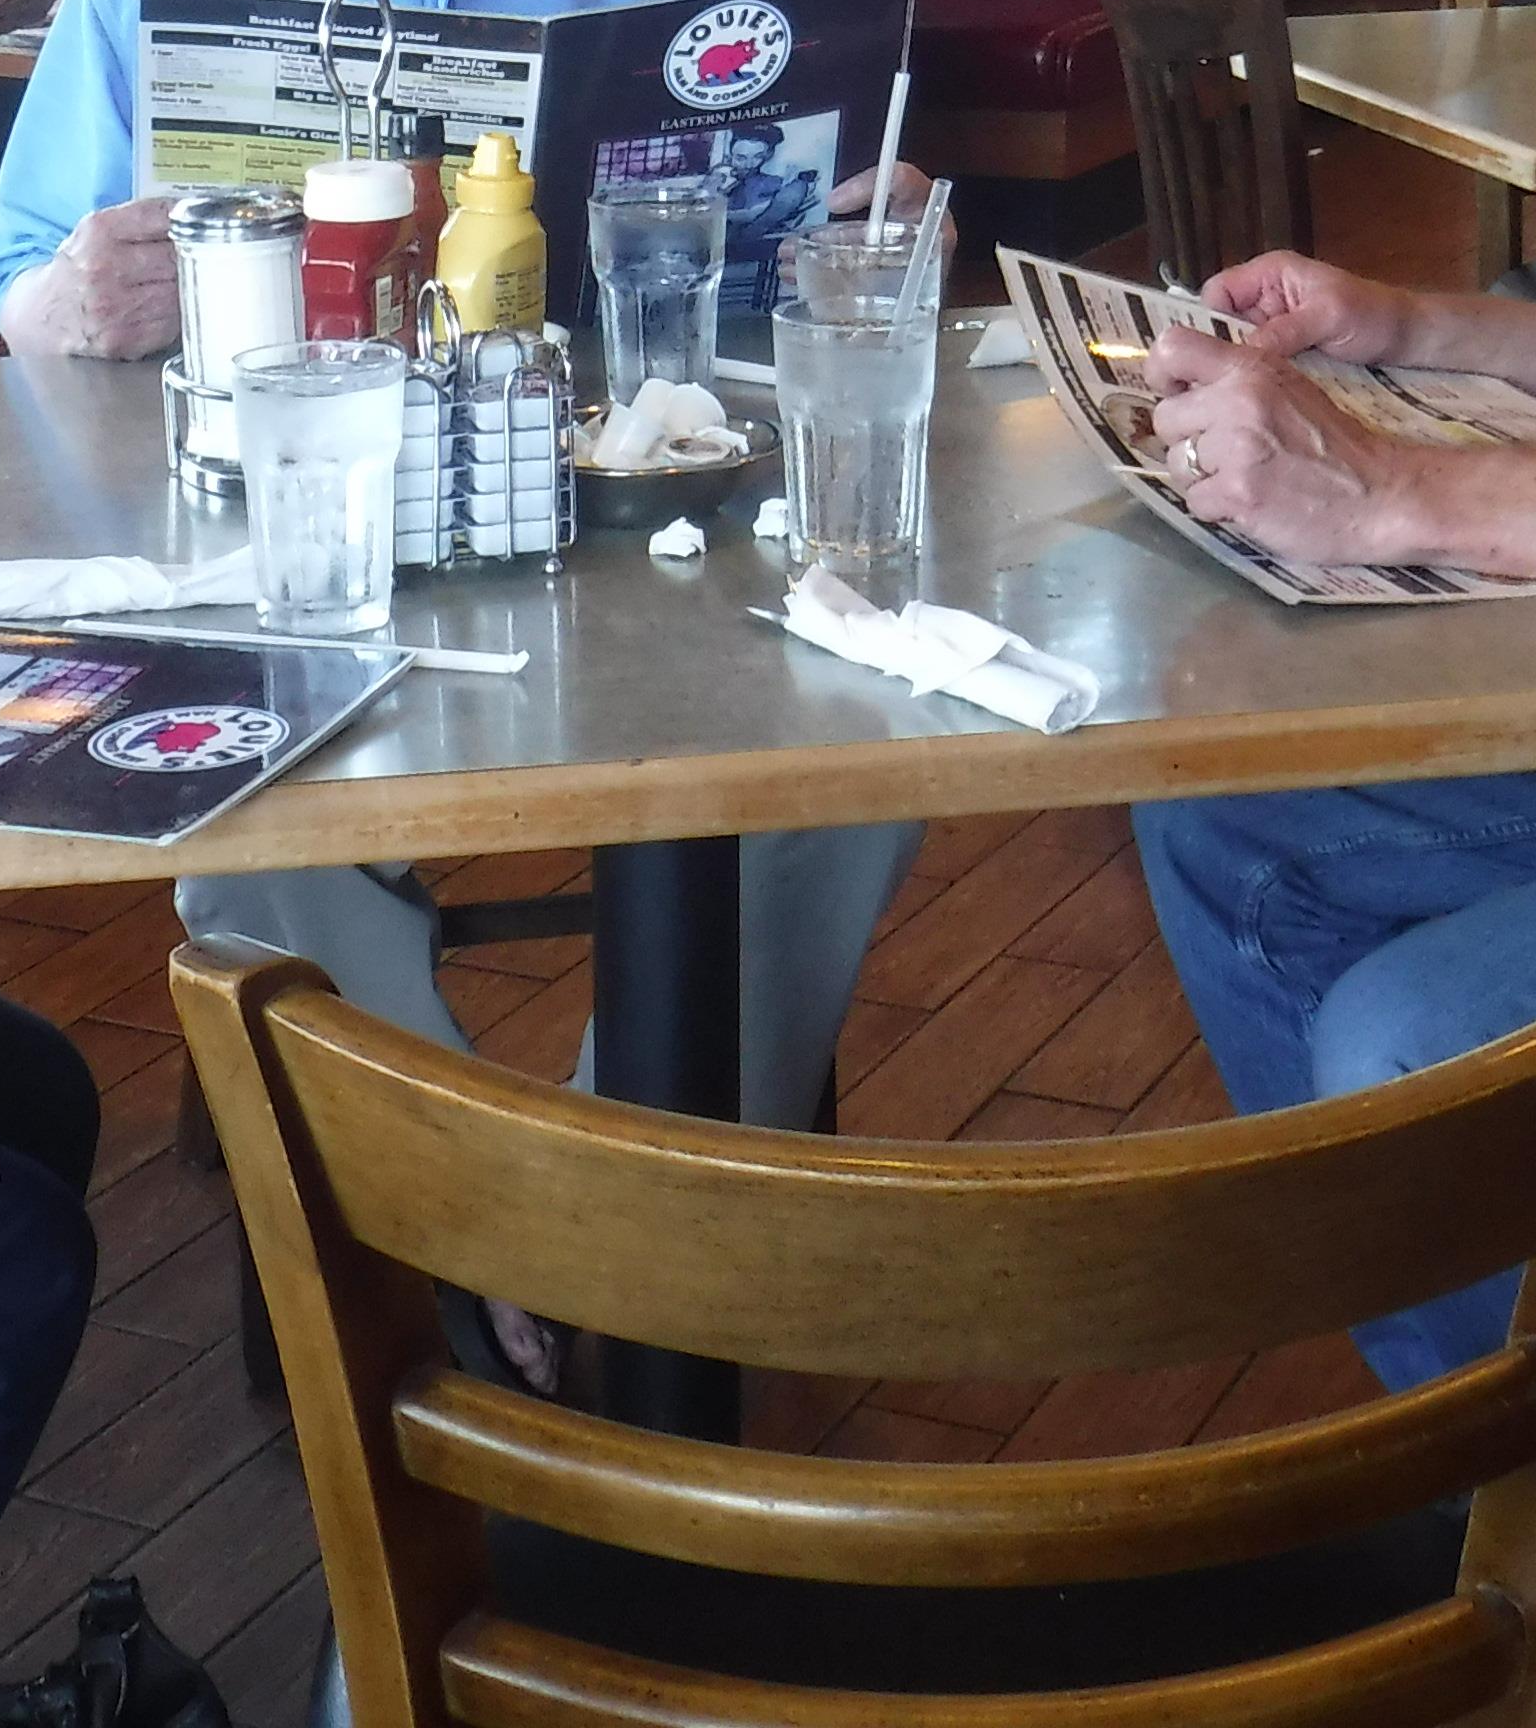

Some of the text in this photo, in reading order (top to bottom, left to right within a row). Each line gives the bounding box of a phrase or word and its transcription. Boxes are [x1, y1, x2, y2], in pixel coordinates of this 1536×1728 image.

[248, 15, 440, 42] Breakfast erved Aytime!
[674, 9, 784, 57] LOUIE'S
[232, 37, 311, 53] Fresh Eggs!
[432, 55, 498, 70] Breakfast
[685, 87, 709, 100] AND
[660, 102, 789, 132] EASTERN MARKET
